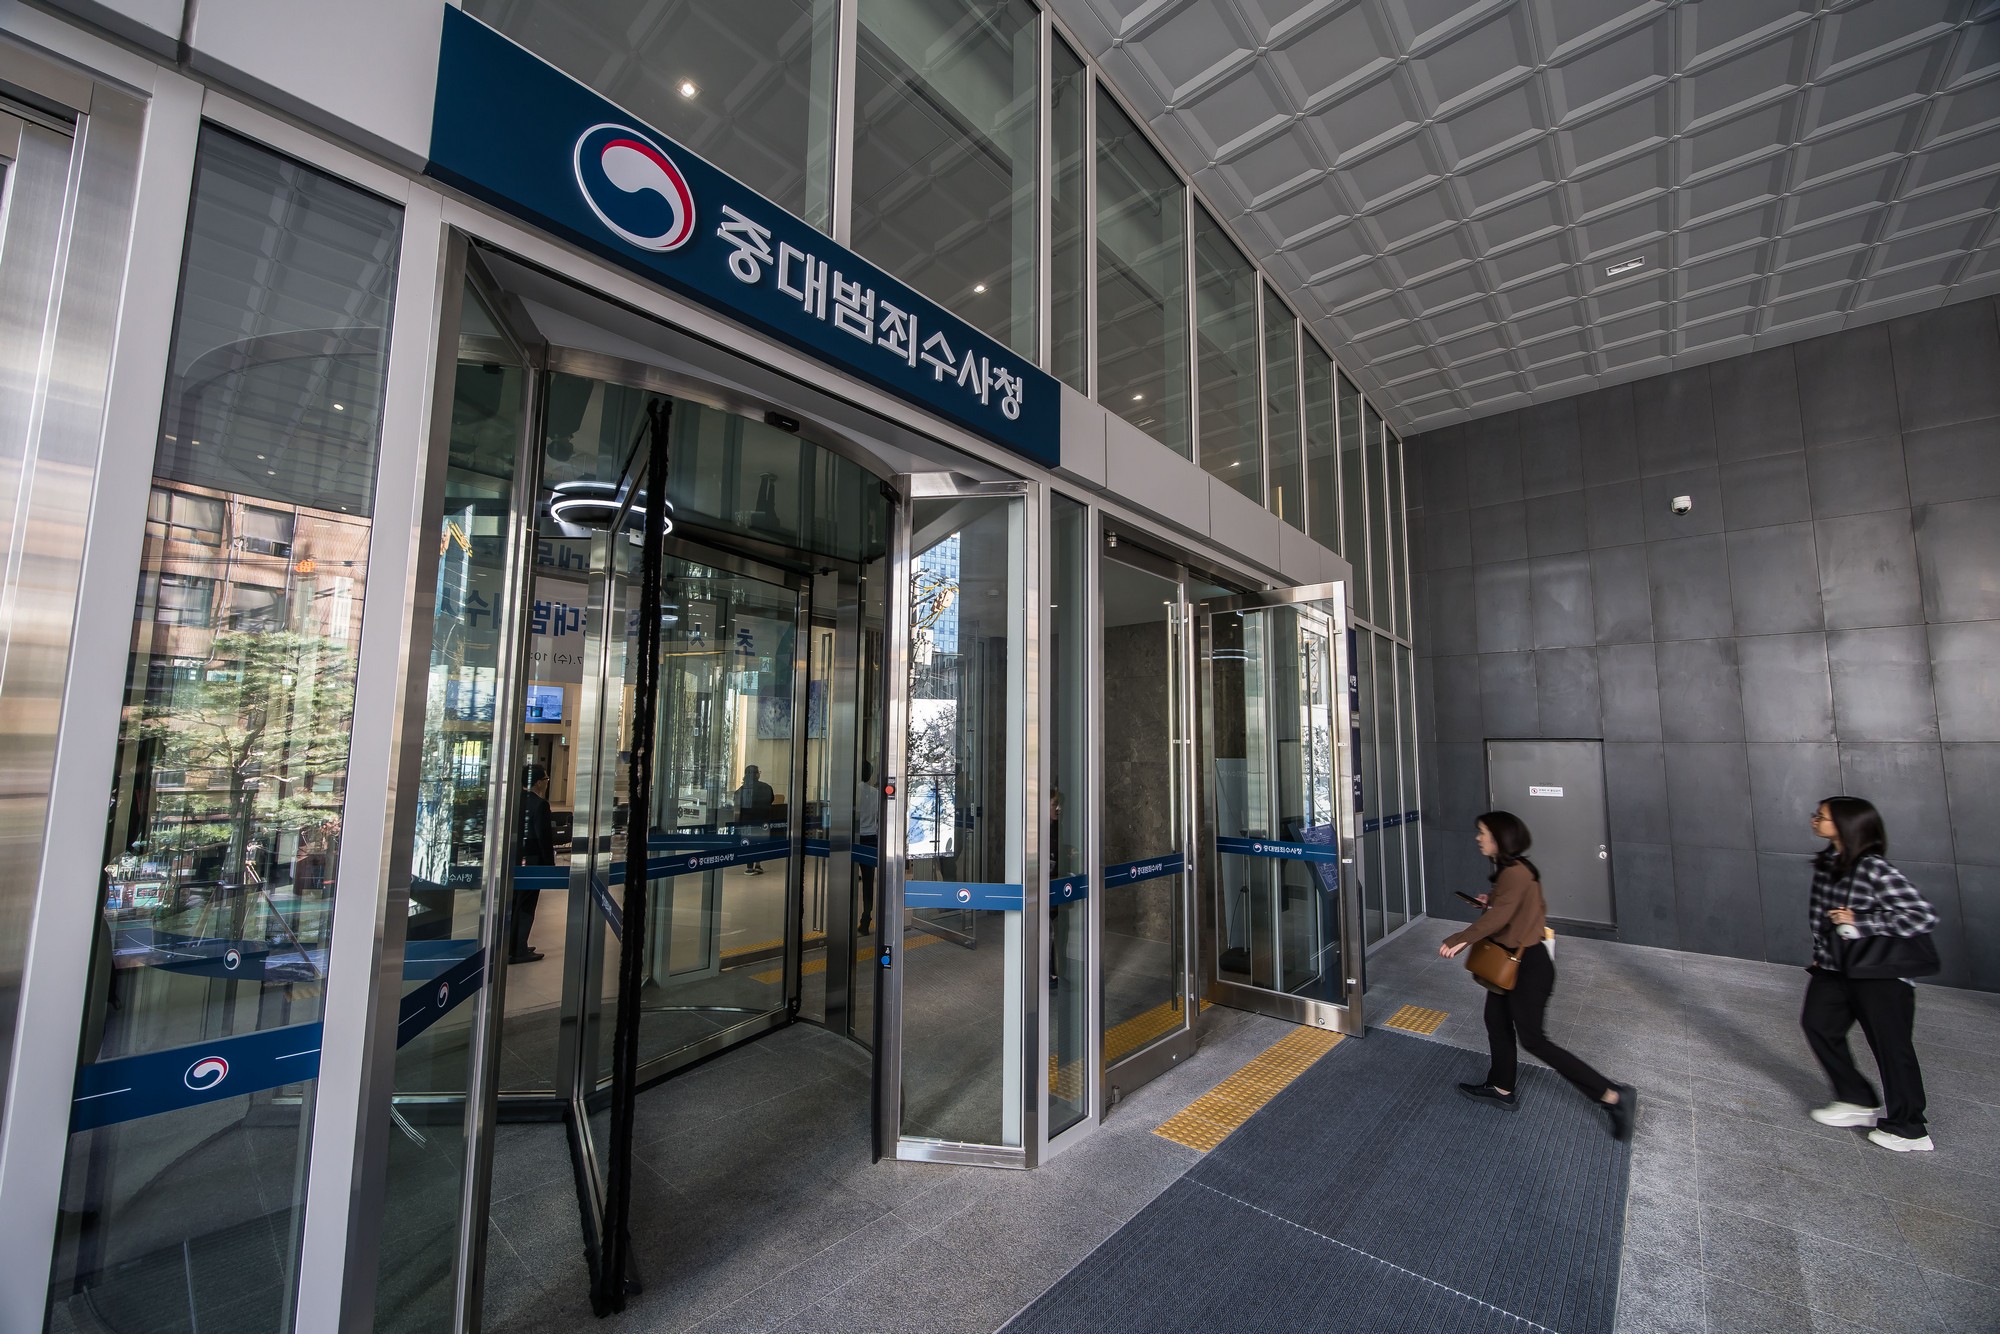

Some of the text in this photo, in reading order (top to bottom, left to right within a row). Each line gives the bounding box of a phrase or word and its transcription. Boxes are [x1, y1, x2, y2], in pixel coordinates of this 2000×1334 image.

[716, 204, 1023, 421] 중대범죄수사청
[1263, 845, 1302, 855] 중대범죄수사청
[699, 853, 735, 866] 중대범죄수사청
